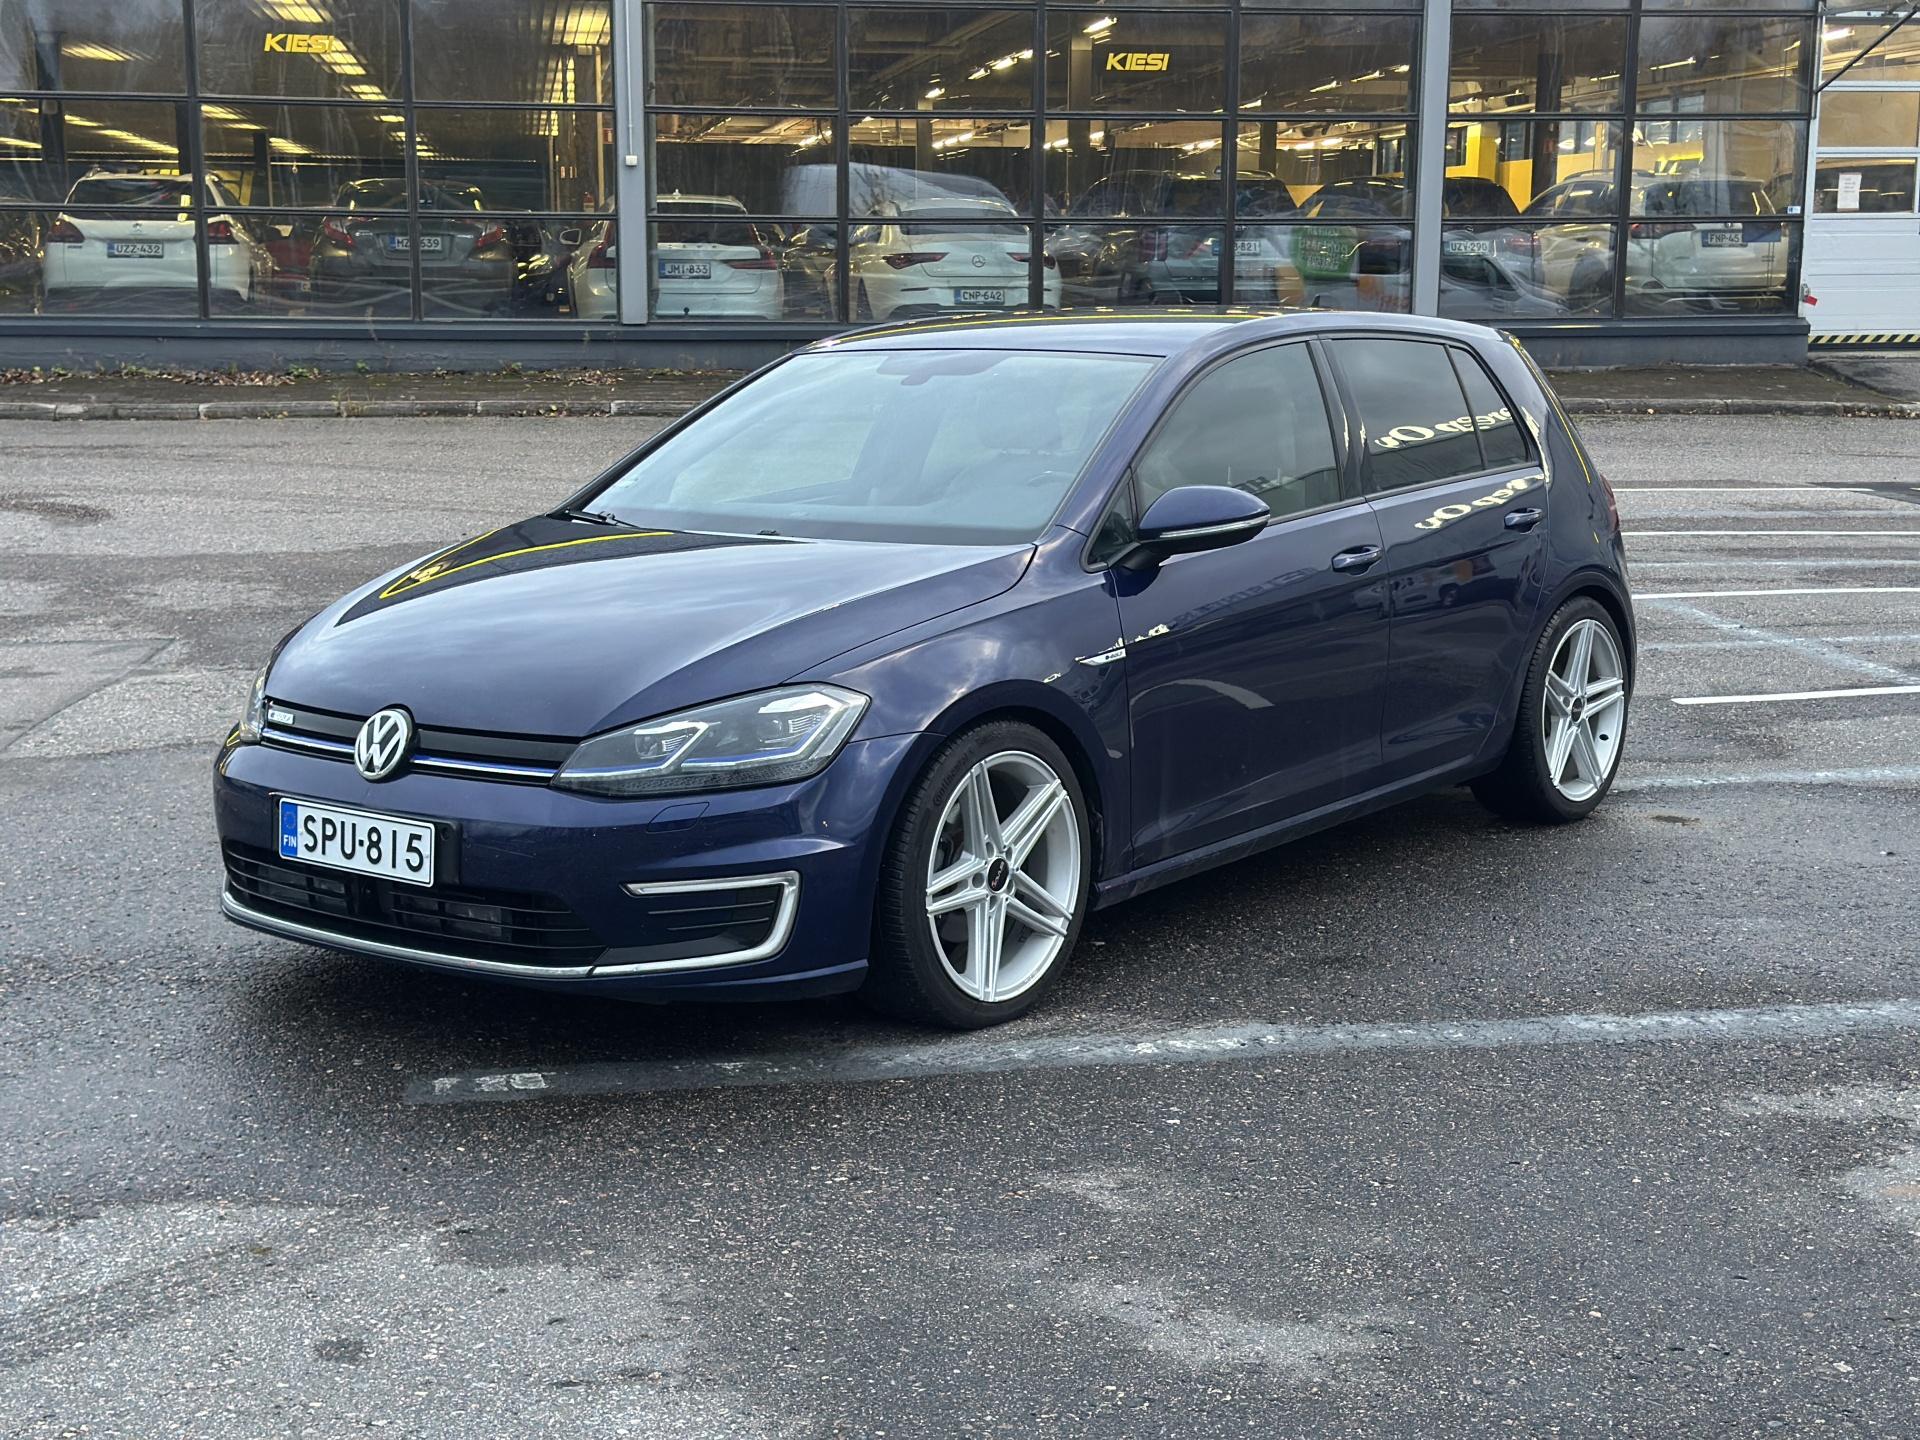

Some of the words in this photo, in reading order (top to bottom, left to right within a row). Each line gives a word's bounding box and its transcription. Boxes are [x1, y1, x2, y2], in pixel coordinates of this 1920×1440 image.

[264, 33, 335, 53] KIESI
[1106, 53, 1170, 71] KIESI
[116, 244, 161, 254] UZZ-432
[963, 291, 1002, 301] CNP-642
[283, 834, 297, 848] FIN
[304, 814, 424, 873] SPU-815
